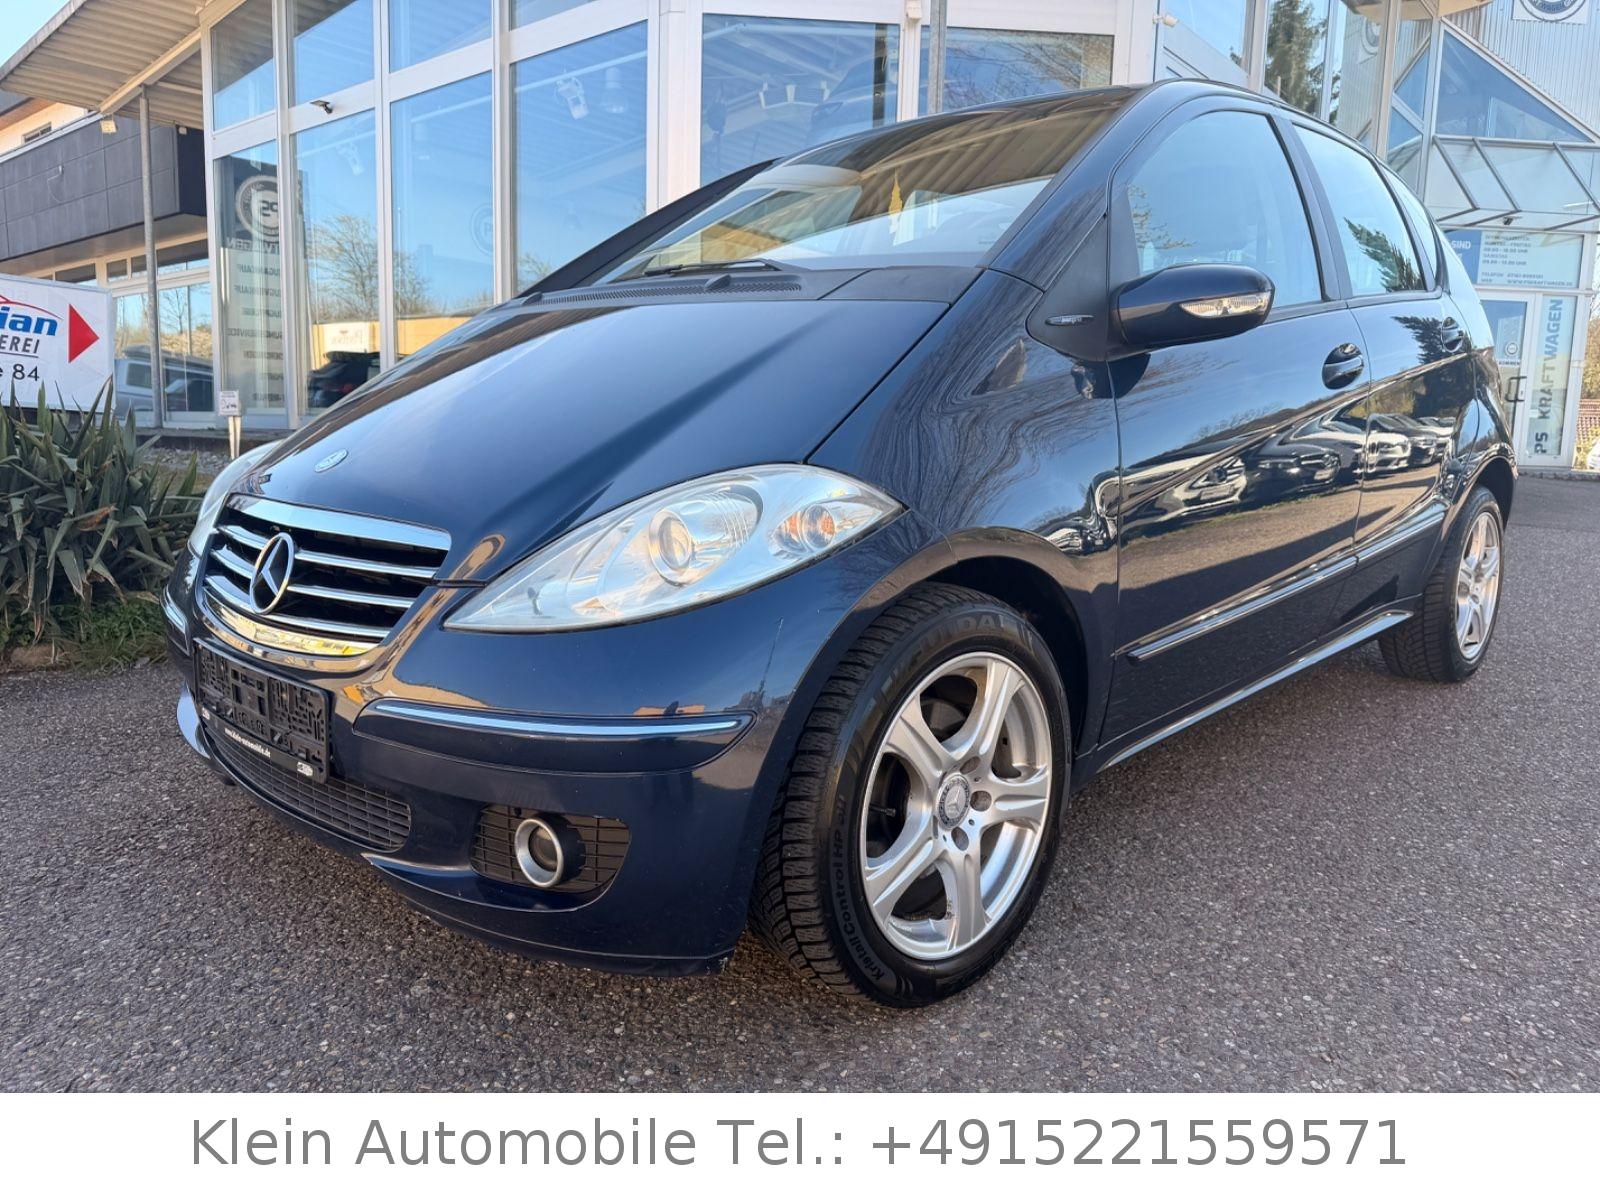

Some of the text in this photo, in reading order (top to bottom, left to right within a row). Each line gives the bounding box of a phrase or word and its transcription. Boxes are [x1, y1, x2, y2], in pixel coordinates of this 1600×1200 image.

[0, 334, 40, 354] EREI
[12, 363, 40, 381] 84
[1534, 300, 1563, 454] PS KRAFTWAGEN
